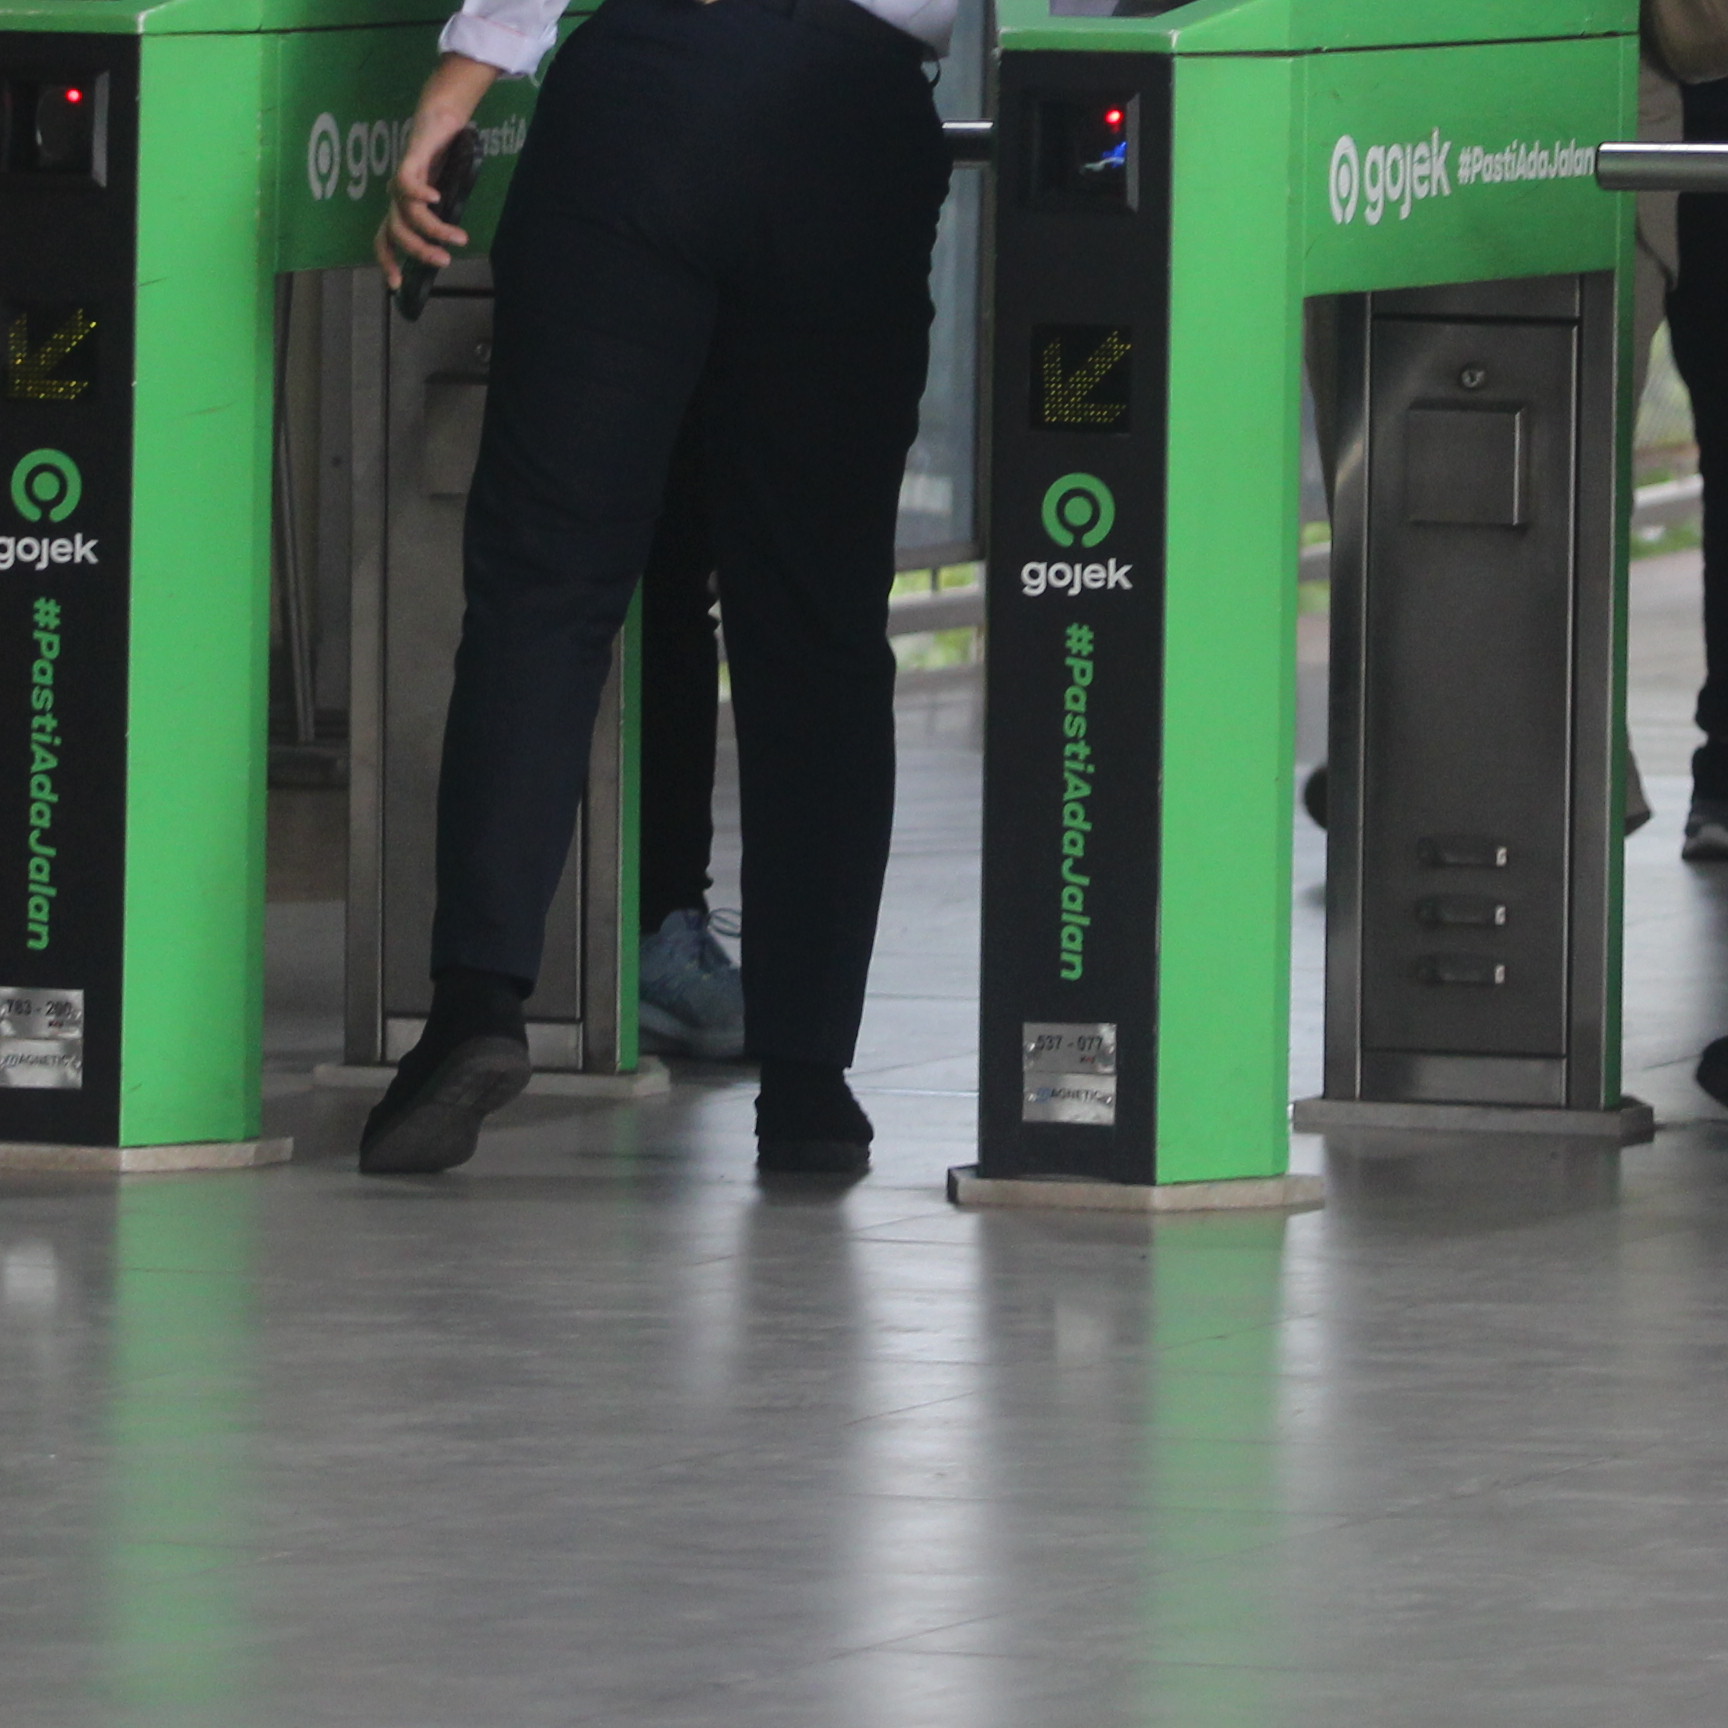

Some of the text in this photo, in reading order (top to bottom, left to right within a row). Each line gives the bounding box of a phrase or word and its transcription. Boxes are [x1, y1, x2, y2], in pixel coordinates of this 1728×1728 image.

[1363, 126, 1595, 226] gojek #PastiAdaJalan
[1020, 557, 1133, 596] gojek
[26, 596, 62, 952] #PastiAdaJalan
[1059, 622, 1096, 982] #PastiAdaJalan
